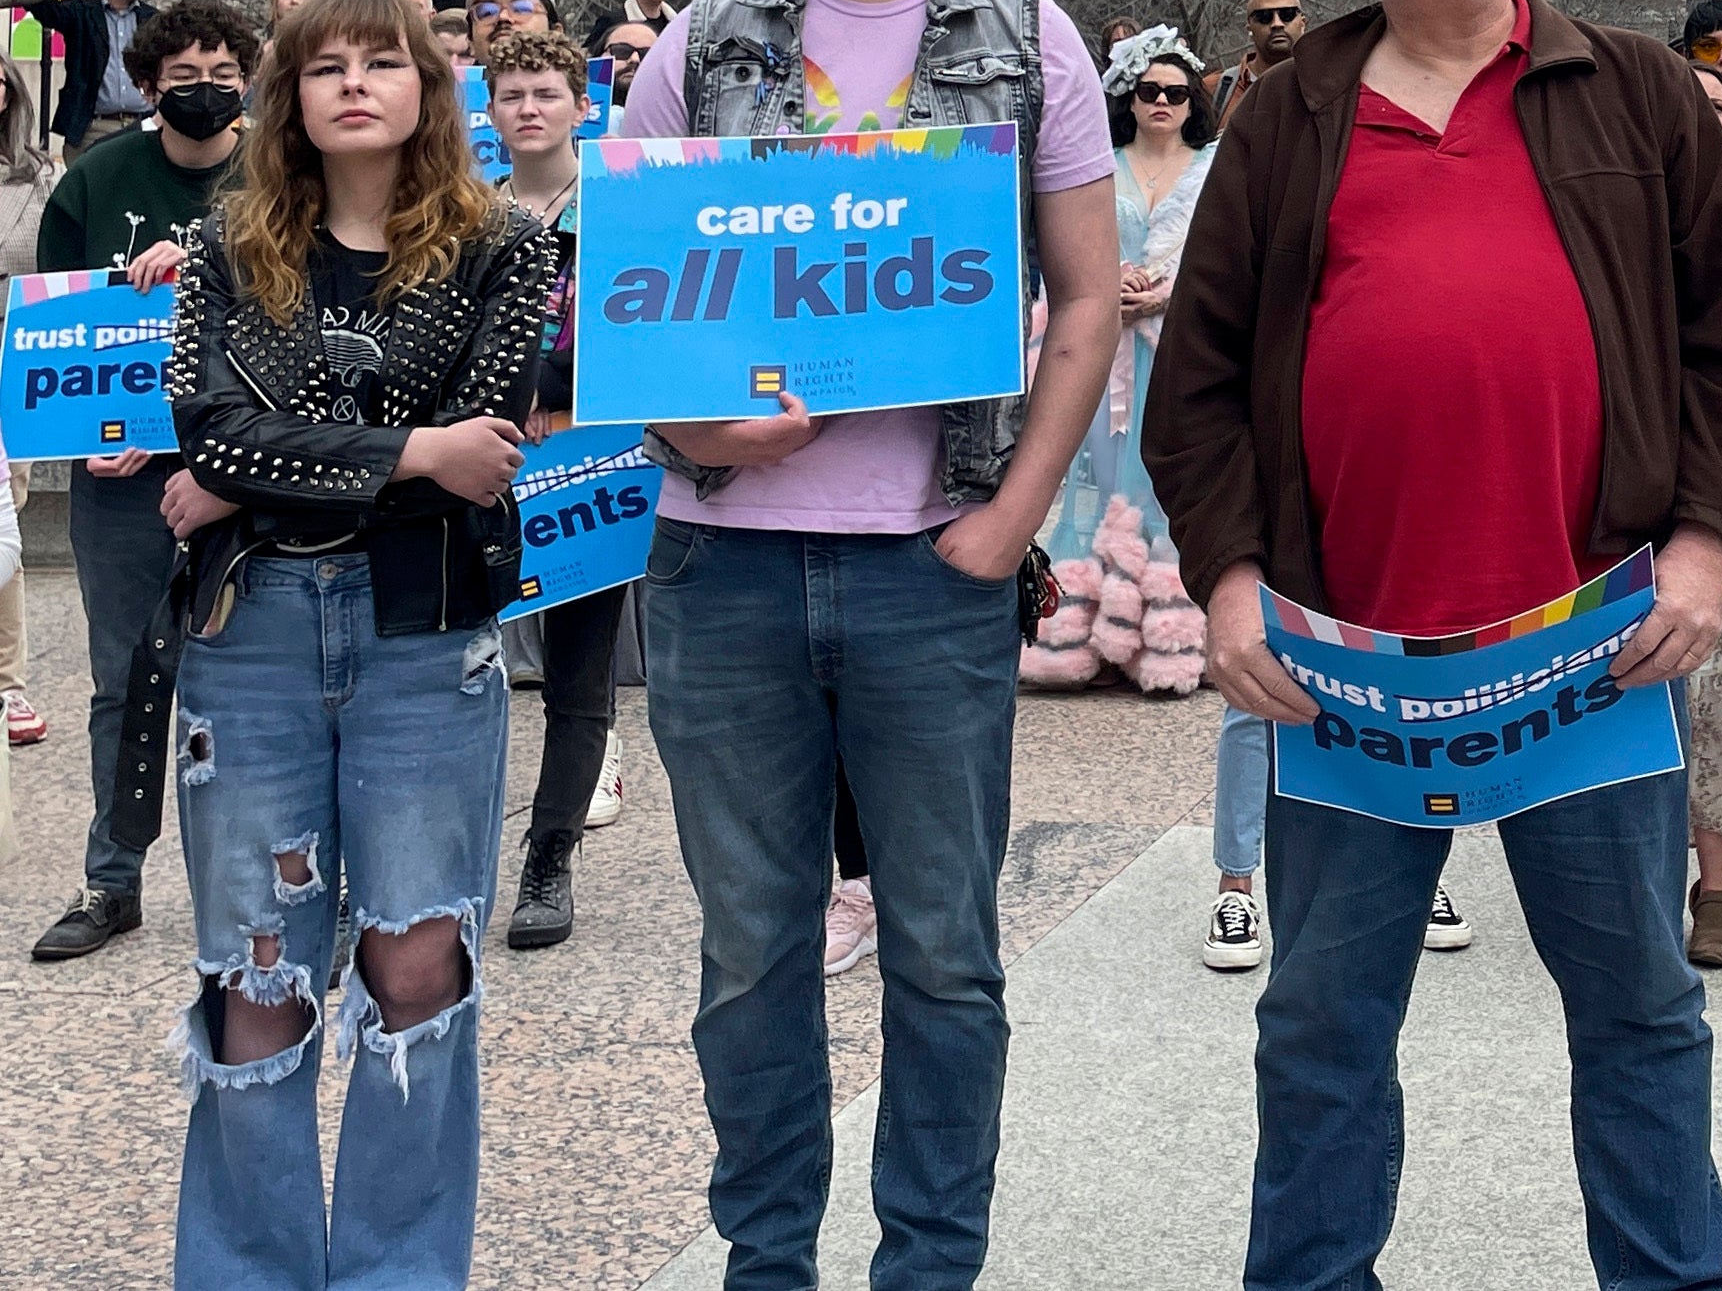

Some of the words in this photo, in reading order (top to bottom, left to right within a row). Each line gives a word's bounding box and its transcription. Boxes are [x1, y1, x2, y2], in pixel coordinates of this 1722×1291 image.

[697, 203, 815, 236] care
[831, 193, 908, 231] for
[604, 248, 744, 324] all
[773, 236, 994, 319] kids
[14, 323, 87, 351] trust
[794, 357, 854, 372] HUMAN
[794, 372, 854, 386] RIGHTS
[512, 446, 650, 503] oliticians
[524, 485, 649, 548] ents
[1280, 653, 1386, 714] trust
[1401, 621, 1640, 721] politicians
[1313, 674, 1625, 769] parents
